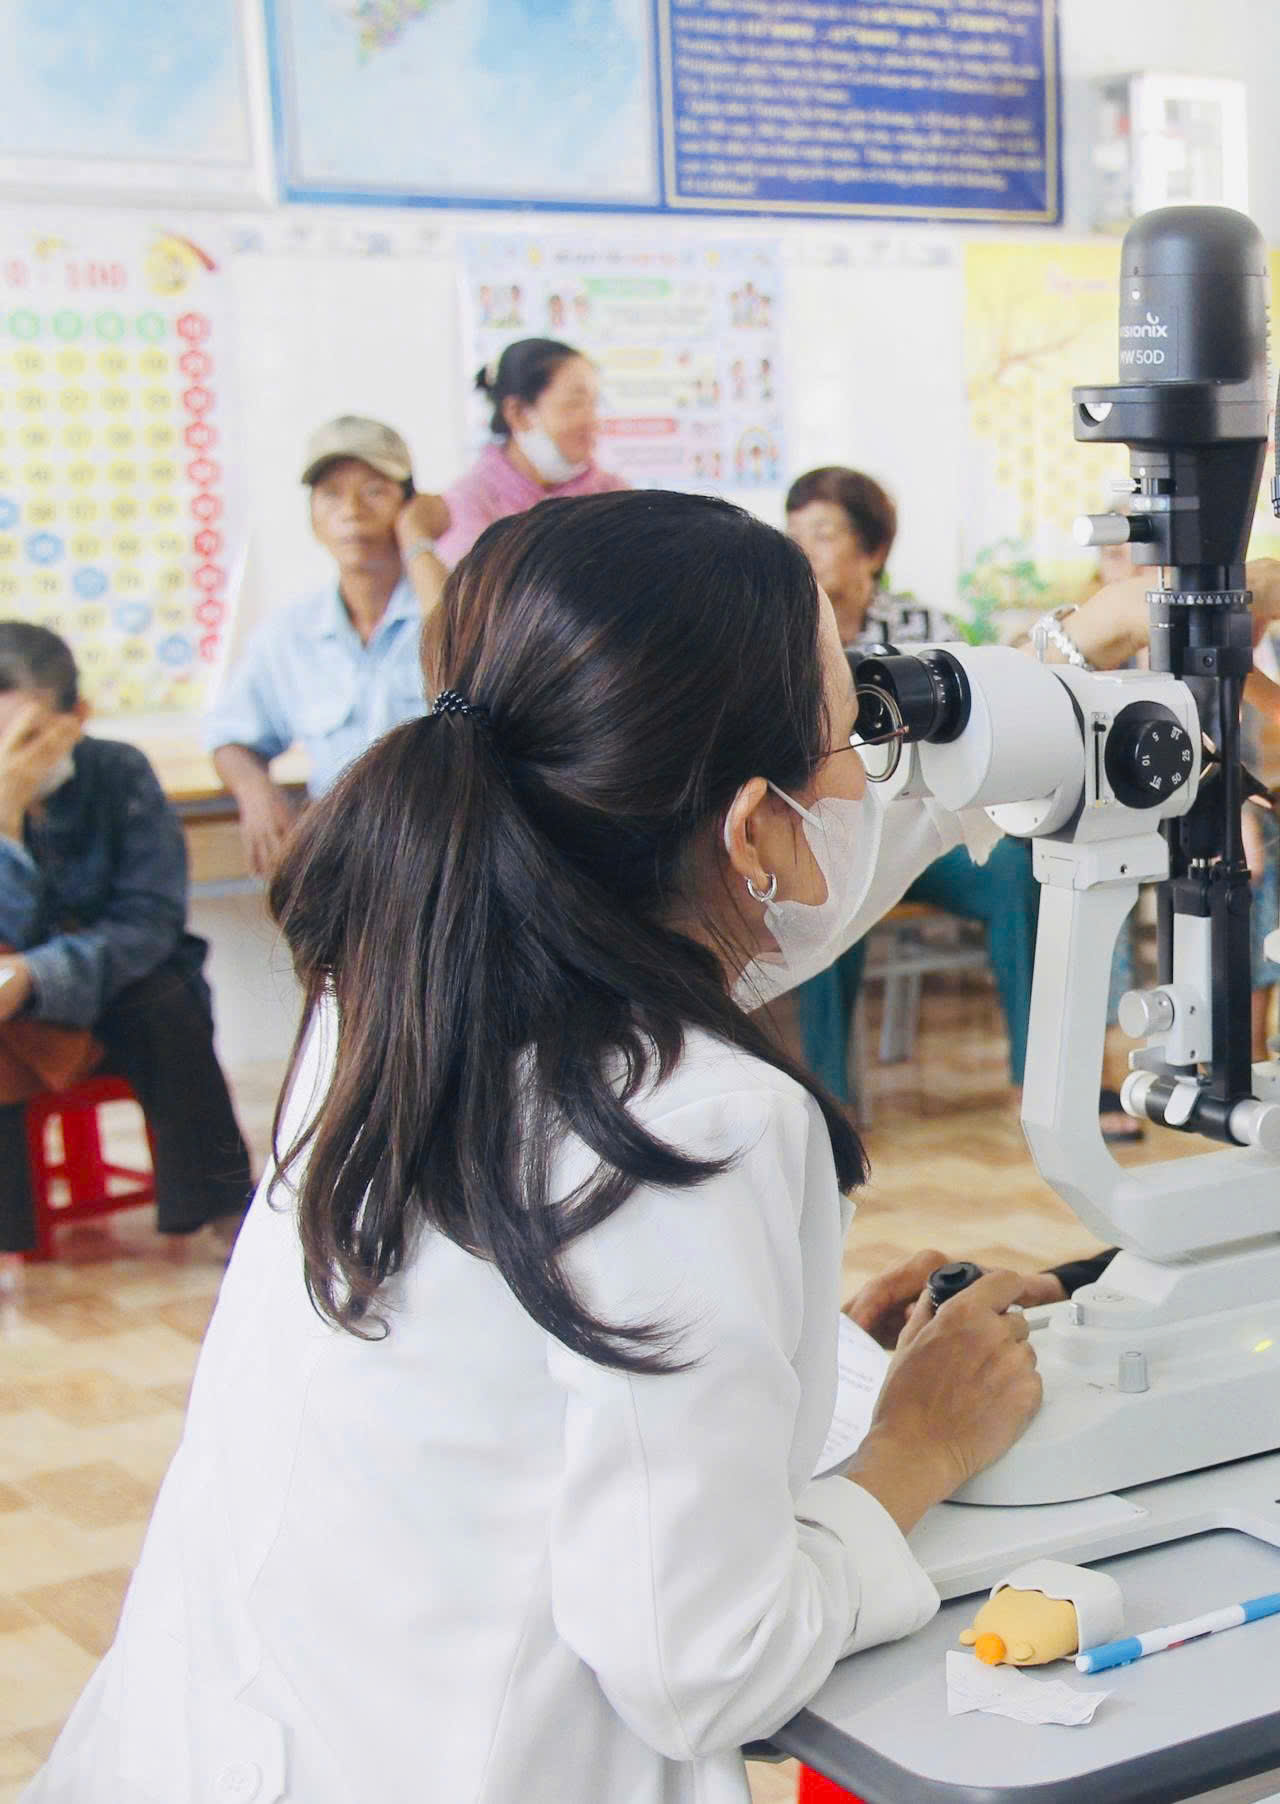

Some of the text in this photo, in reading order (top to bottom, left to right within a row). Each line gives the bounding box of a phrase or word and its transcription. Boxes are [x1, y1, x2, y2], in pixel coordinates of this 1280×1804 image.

[1152, 732, 1160, 742] 5
[1170, 725, 1183, 740] 16
[1142, 754, 1151, 766] 10
[1182, 749, 1191, 762] 25
[1171, 772, 1182, 785] 50
